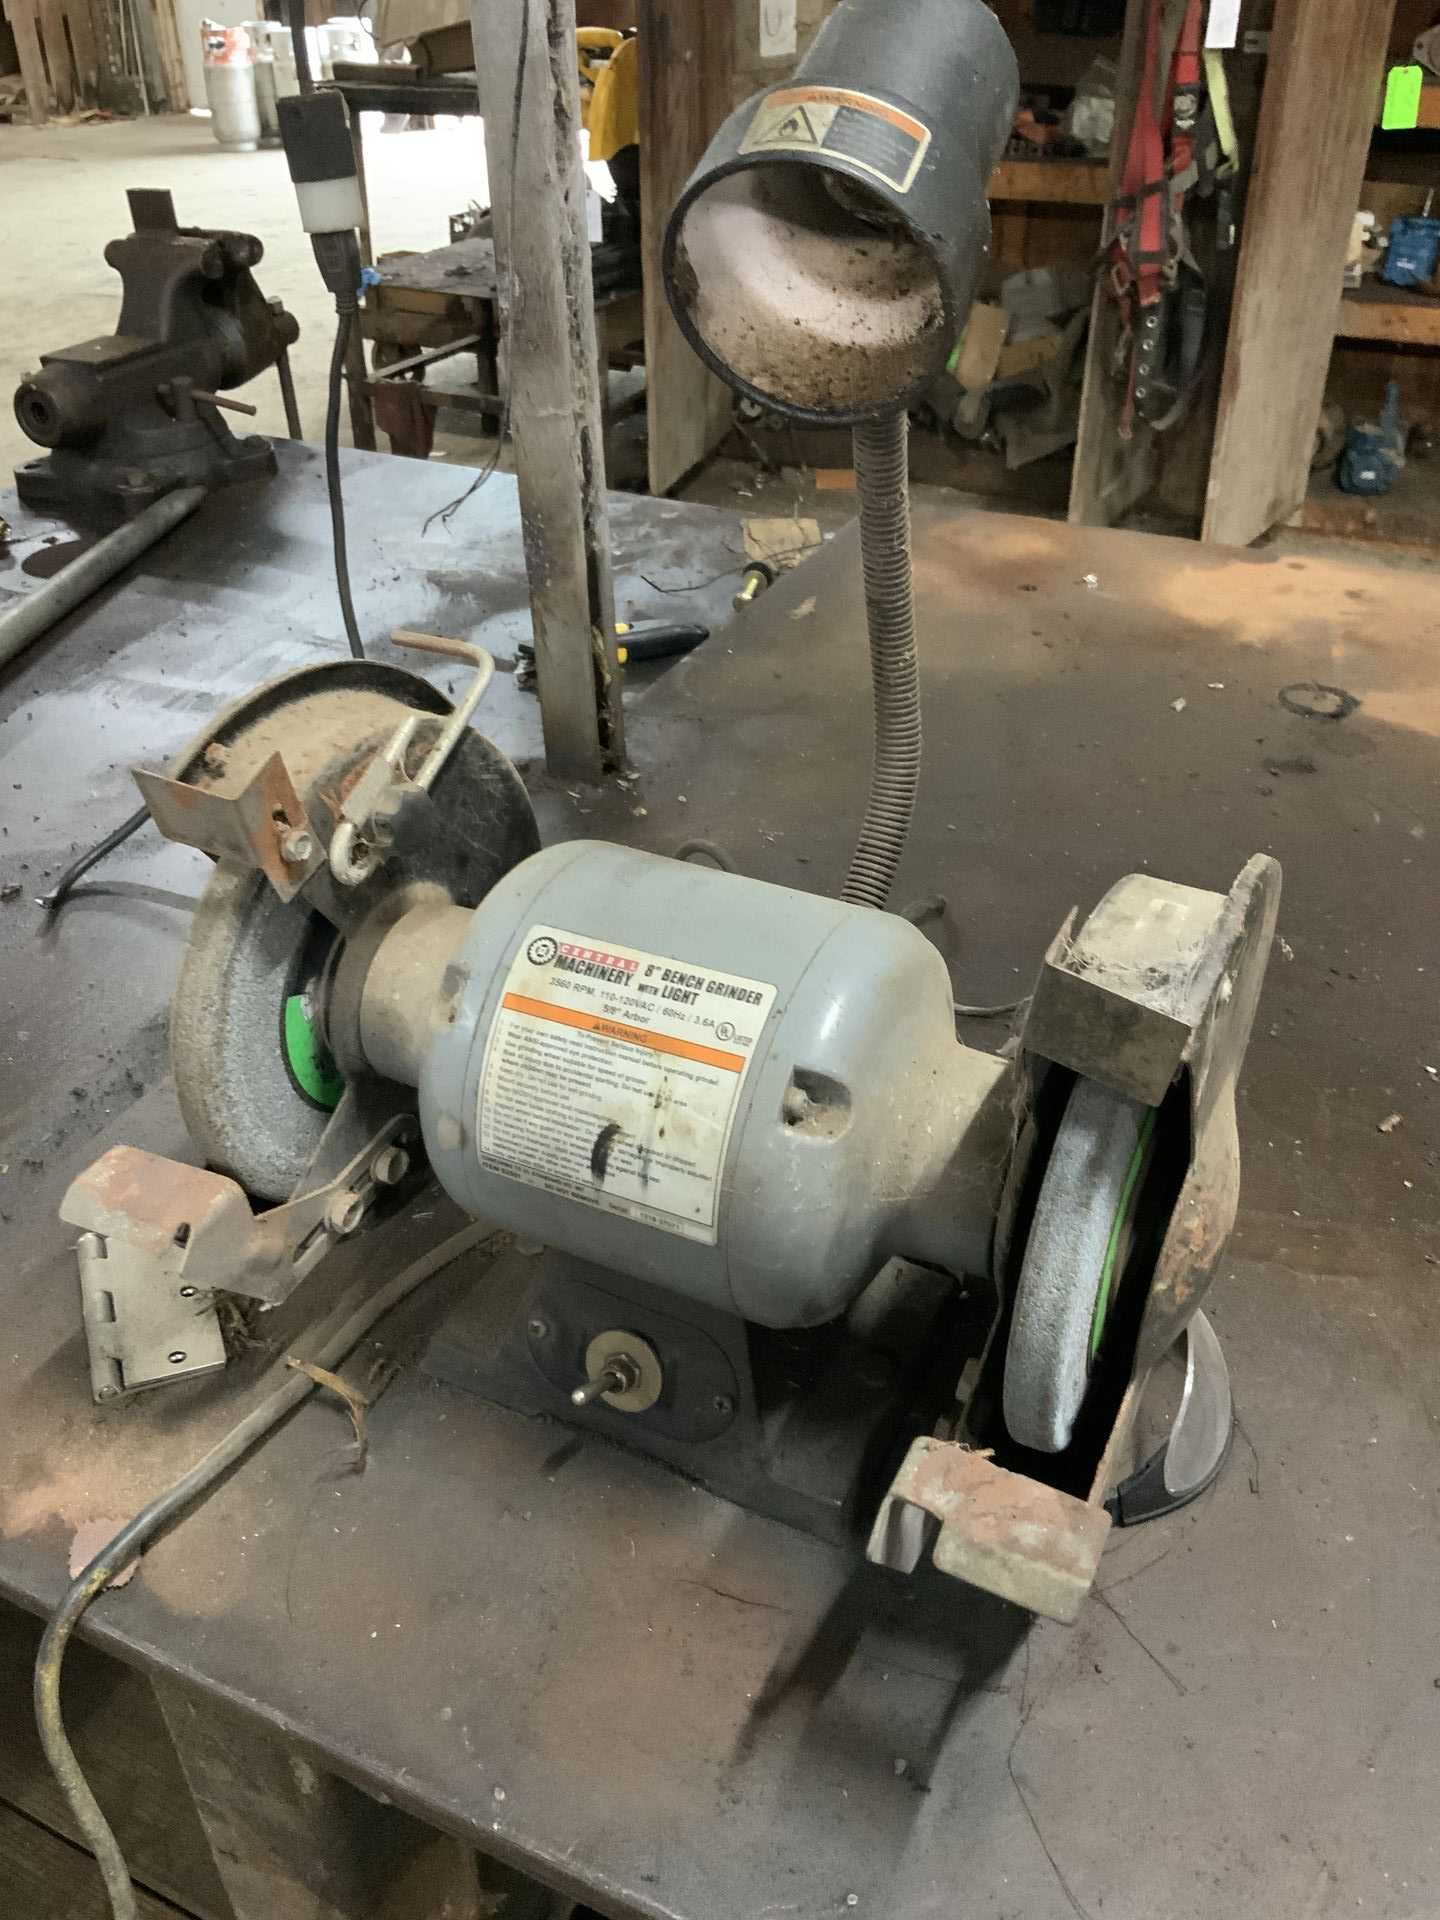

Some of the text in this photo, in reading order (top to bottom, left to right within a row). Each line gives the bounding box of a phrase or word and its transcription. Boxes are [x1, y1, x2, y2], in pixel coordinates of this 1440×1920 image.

[553, 954, 634, 986] MACHINERY
[661, 968, 705, 989] BENCH
[705, 980, 763, 1005] GRINDER
[661, 985, 699, 1005] LIGHT
[623, 1010, 650, 1023] Arbor
[600, 1024, 648, 1043] WARNING
